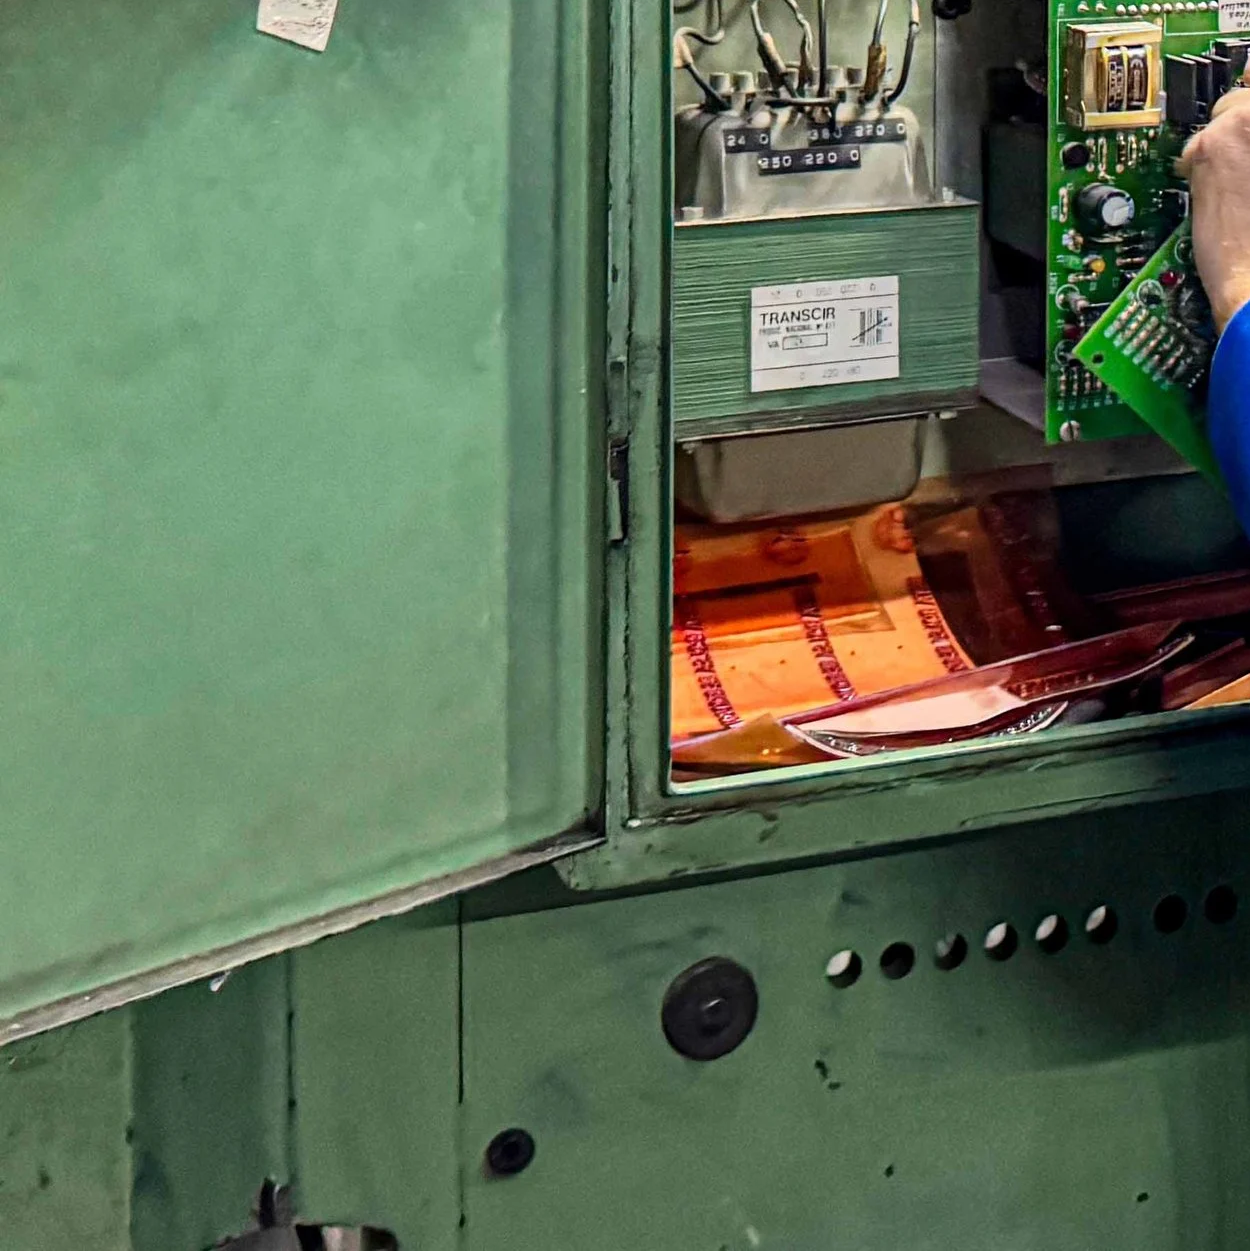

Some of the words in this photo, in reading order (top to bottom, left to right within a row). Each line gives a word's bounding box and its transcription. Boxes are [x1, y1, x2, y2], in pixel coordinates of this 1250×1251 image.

[854, 123, 885, 138] 220
[896, 122, 906, 134] 0
[726, 134, 746, 147] 24
[759, 133, 769, 145] 0
[804, 152, 838, 166] 220
[850, 150, 859, 162] 0
[760, 307, 836, 326] TRANSCIR
